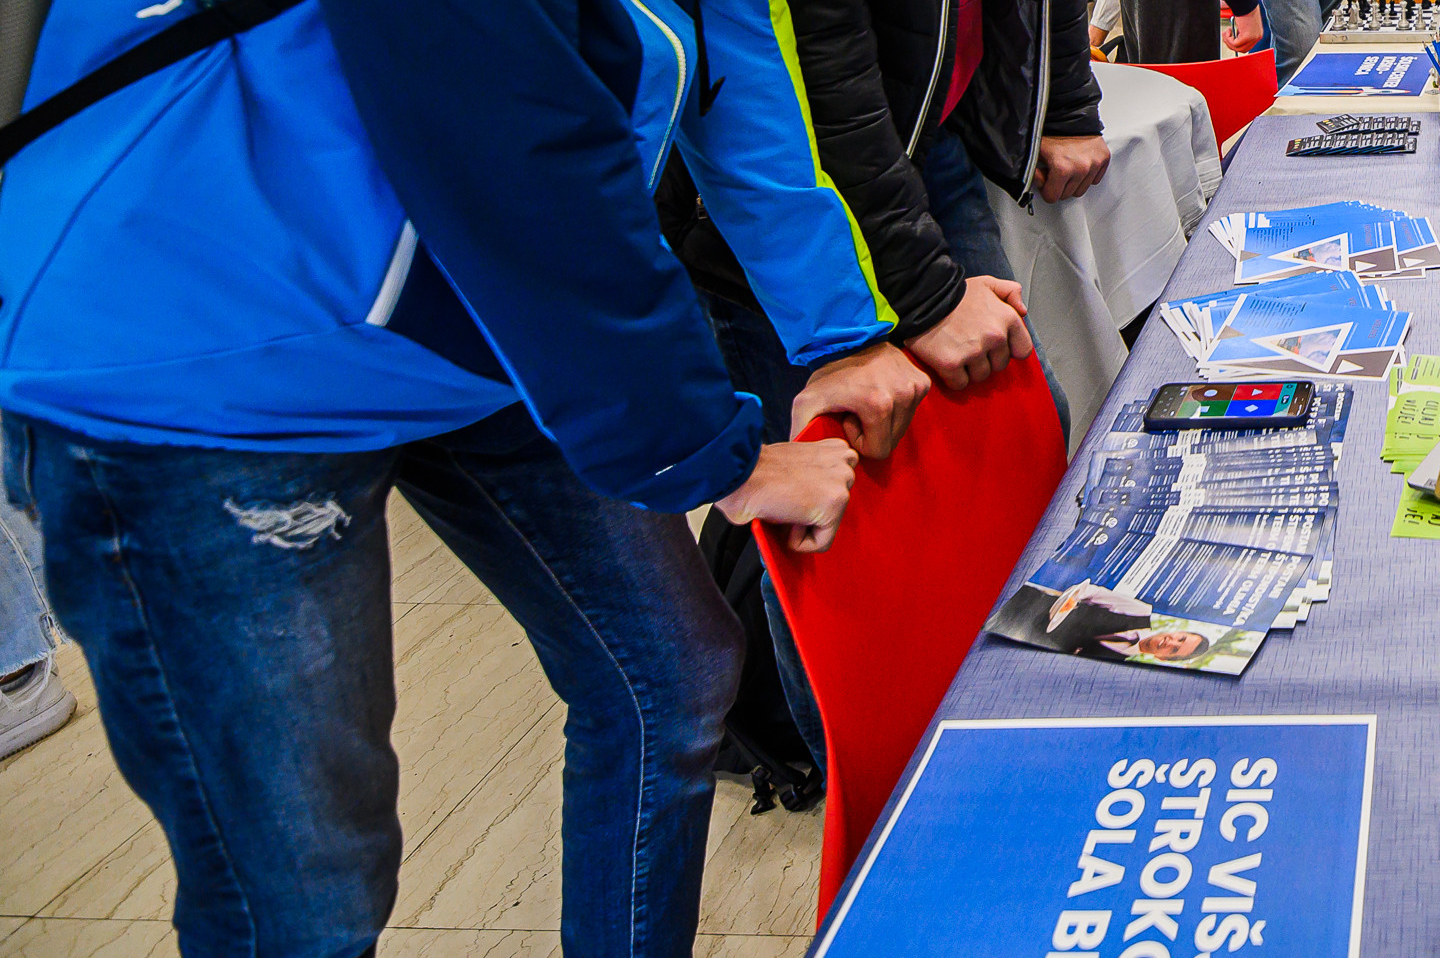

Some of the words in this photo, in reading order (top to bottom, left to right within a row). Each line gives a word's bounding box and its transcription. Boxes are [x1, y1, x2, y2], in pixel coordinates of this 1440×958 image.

[1251, 551, 1272, 578] TERM
[1268, 555, 1302, 599] POSTANI
[1067, 758, 1170, 899] ŠOLA
[1219, 757, 1278, 843] SIC
[1045, 909, 1113, 958] B
[1194, 852, 1267, 958] VIŠ
